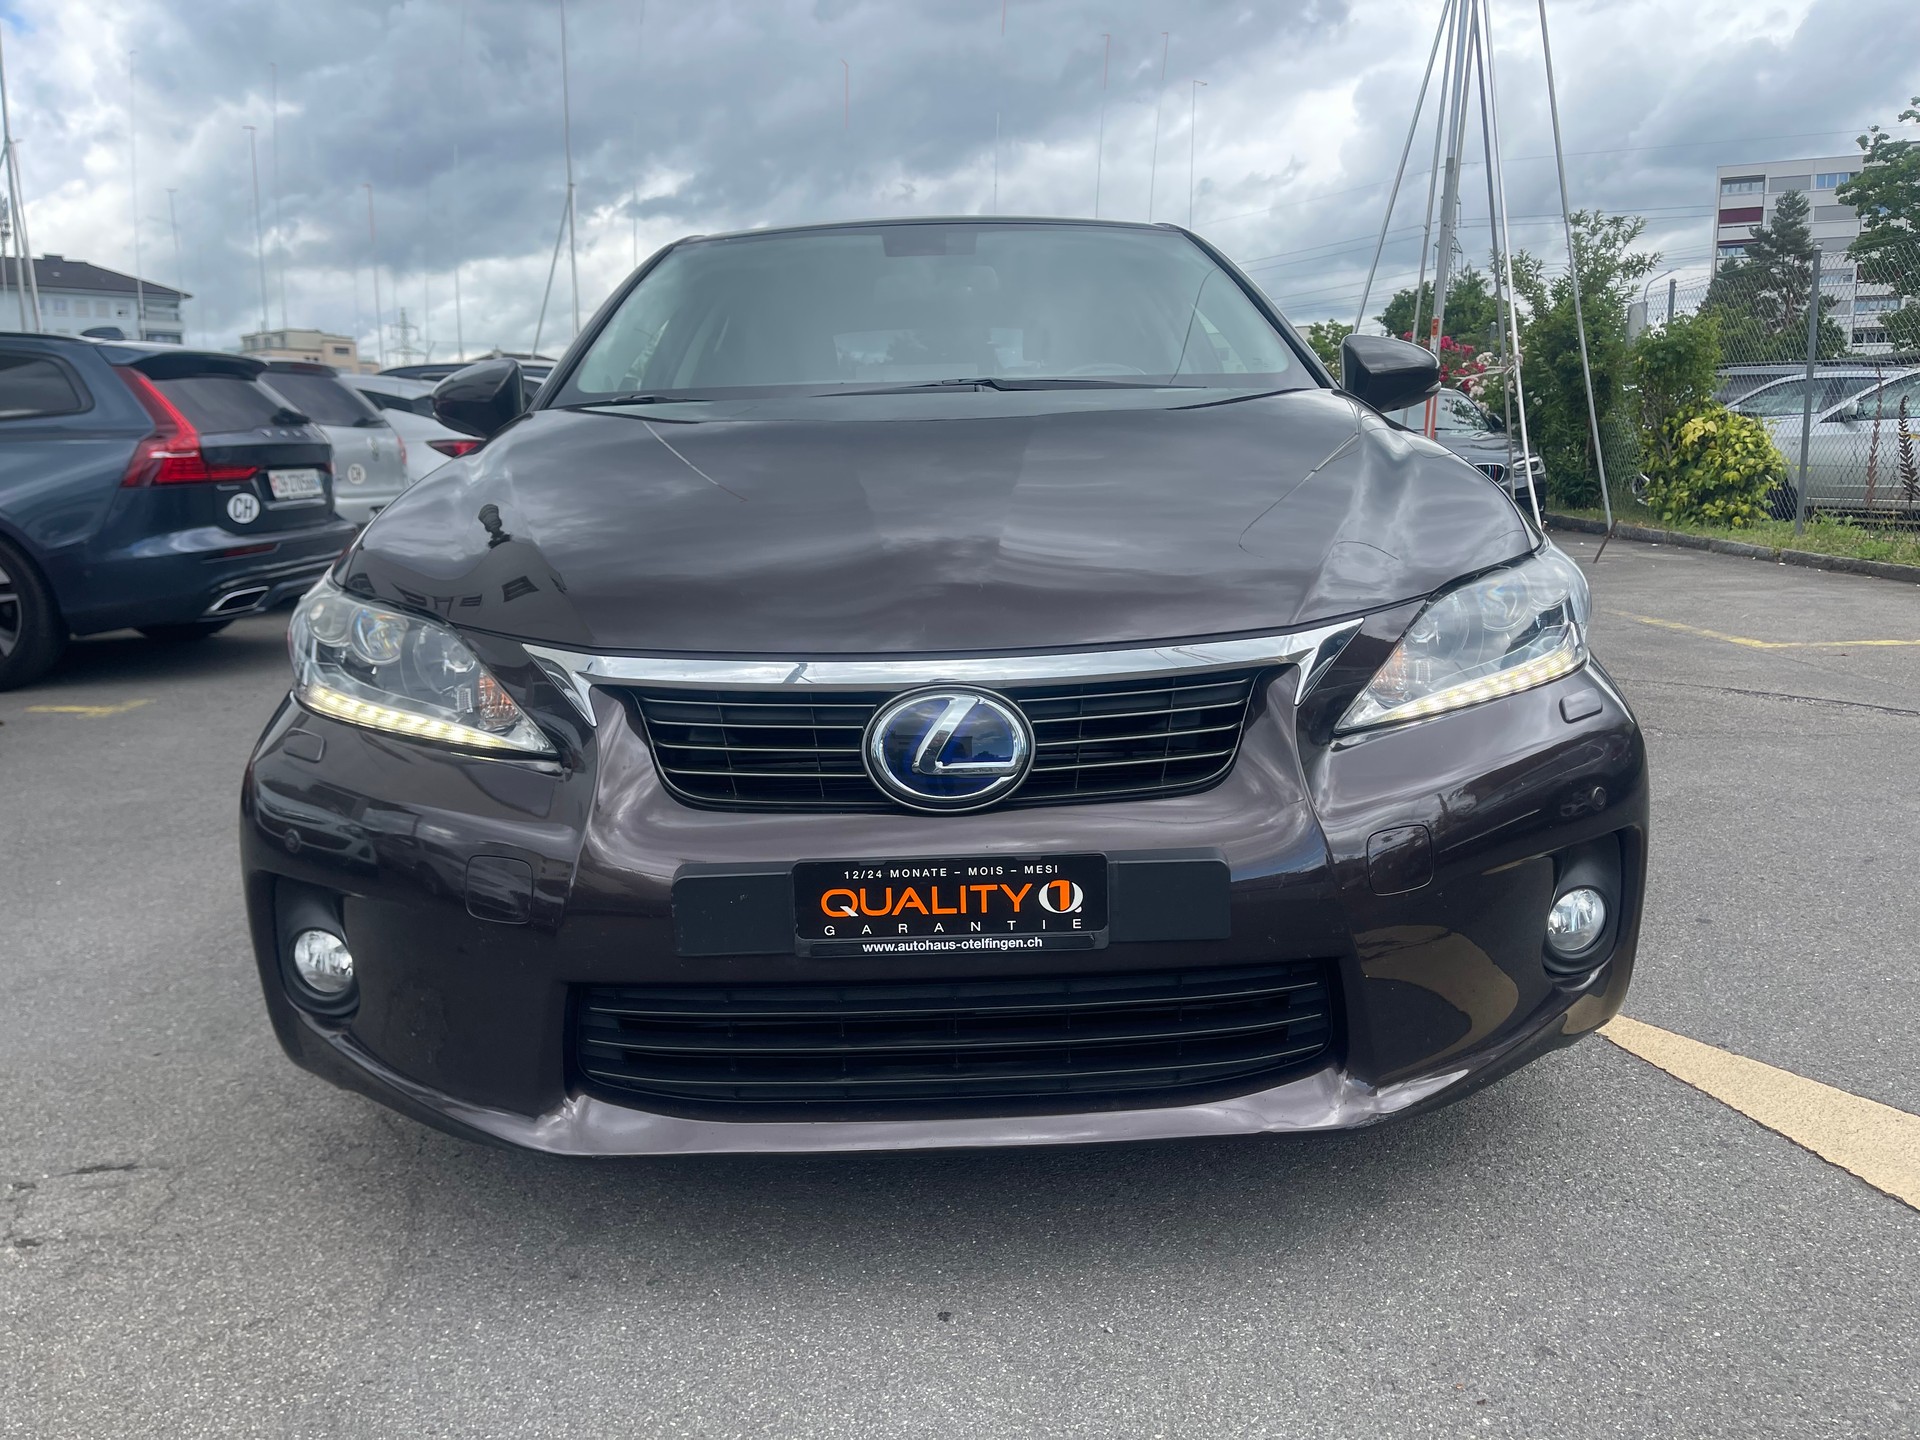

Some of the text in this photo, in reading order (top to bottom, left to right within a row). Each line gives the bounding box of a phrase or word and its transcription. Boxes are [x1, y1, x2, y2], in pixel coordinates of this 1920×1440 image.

[351, 466, 362, 481] CH
[233, 498, 253, 519] CH
[843, 869, 883, 880] 12/24
[889, 868, 948, 878] MONATE
[968, 866, 1004, 876] MOIS
[1024, 864, 1058, 874] MESI
[820, 882, 1033, 918] QUALITY
[823, 918, 1082, 936] GARANTIE
[862, 936, 1043, 953] www.autohaus-otelfingen.ch
